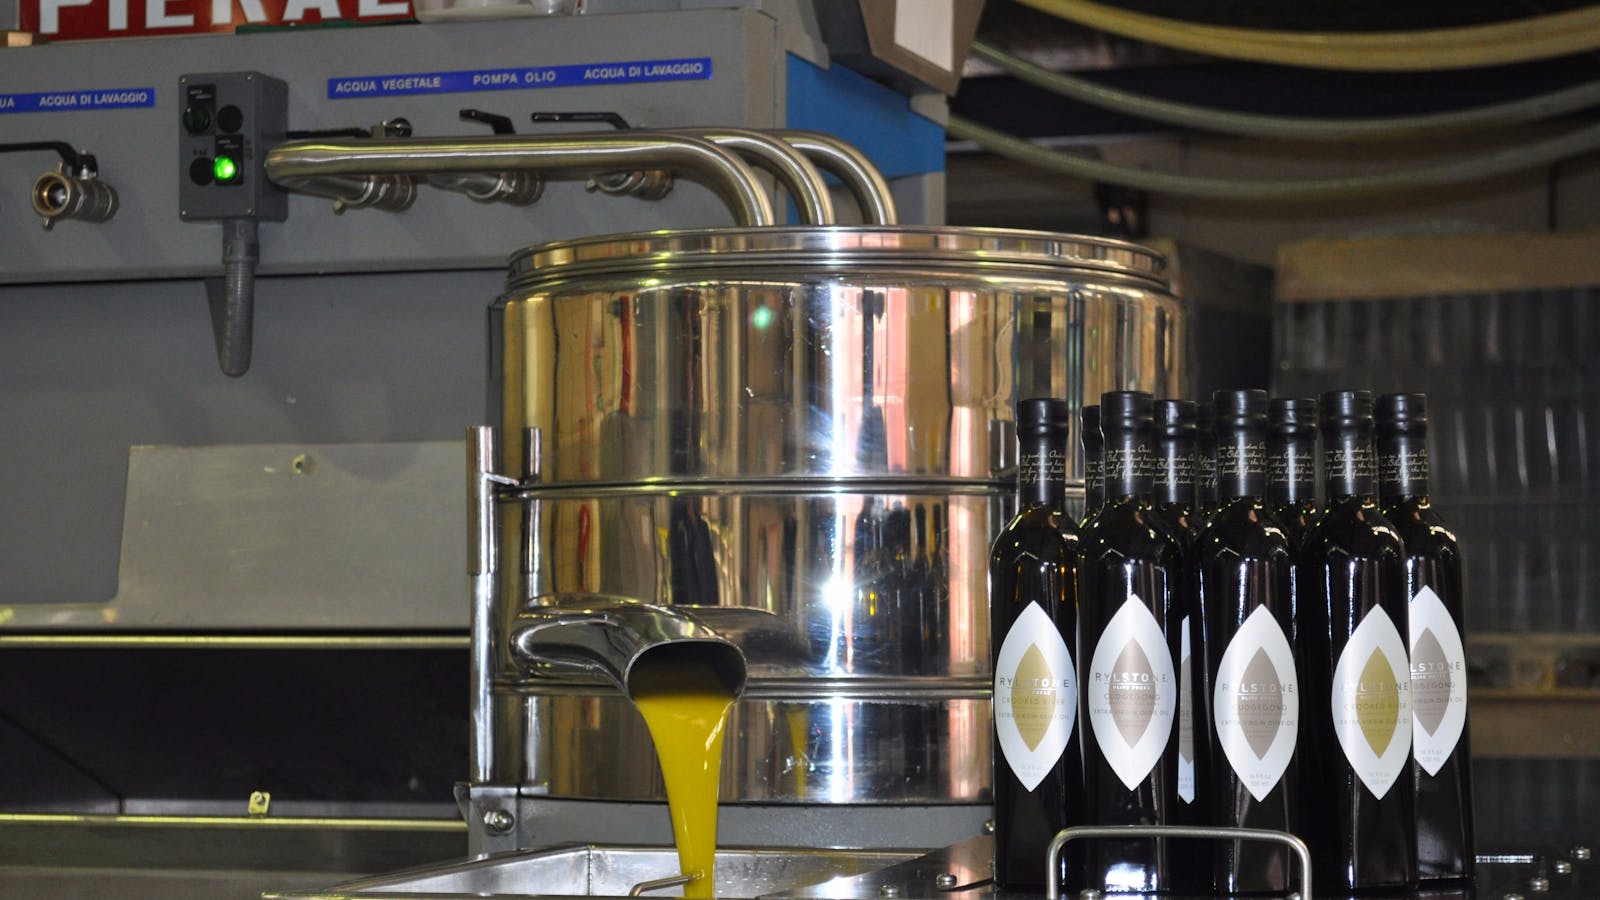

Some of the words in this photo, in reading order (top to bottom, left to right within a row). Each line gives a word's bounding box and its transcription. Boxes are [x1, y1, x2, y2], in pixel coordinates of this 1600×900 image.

[584, 68, 625, 79] ACQUA
[628, 66, 641, 77] DI
[644, 62, 703, 76] LAVAGGIO
[335, 81, 376, 93] ACQUA
[382, 77, 441, 90] VEGETALE
[473, 73, 518, 85] POMPA
[524, 71, 556, 83] OLIO
[39, 95, 77, 106] ACQUA
[80, 94, 92, 105] DI
[94, 92, 148, 104] LAVAGGIO
[1095, 672, 1168, 683] RYLSTONE
